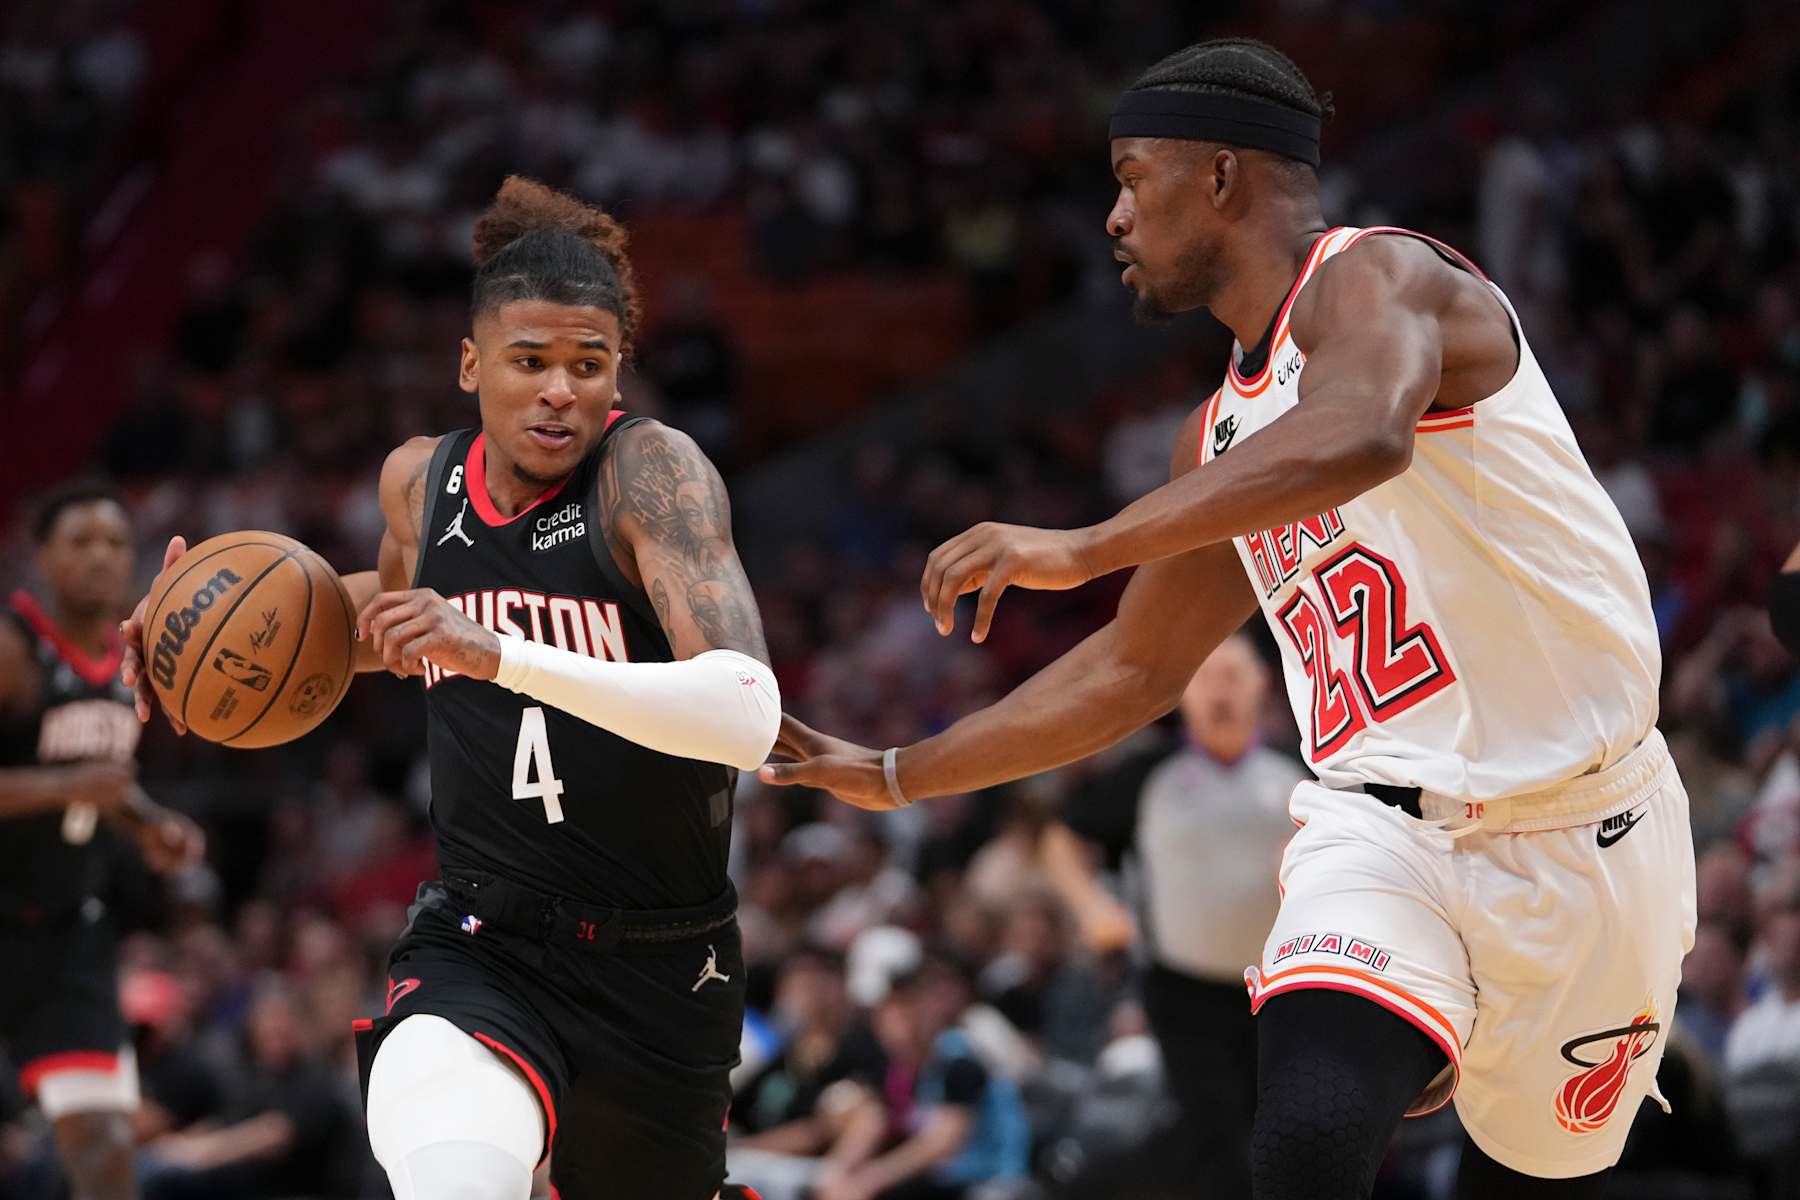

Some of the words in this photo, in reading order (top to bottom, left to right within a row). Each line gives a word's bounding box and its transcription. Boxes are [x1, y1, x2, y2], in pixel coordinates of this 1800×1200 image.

[1214, 414, 1235, 446] NIKE
[446, 464, 464, 495] 6
[536, 503, 582, 531] credit
[532, 522, 586, 551] karma
[152, 567, 243, 691] Wilson
[1276, 540, 1457, 763] 22
[512, 706, 565, 824] 4
[1602, 811, 1633, 833] NIKE
[1273, 933, 1391, 972] MIAMI
